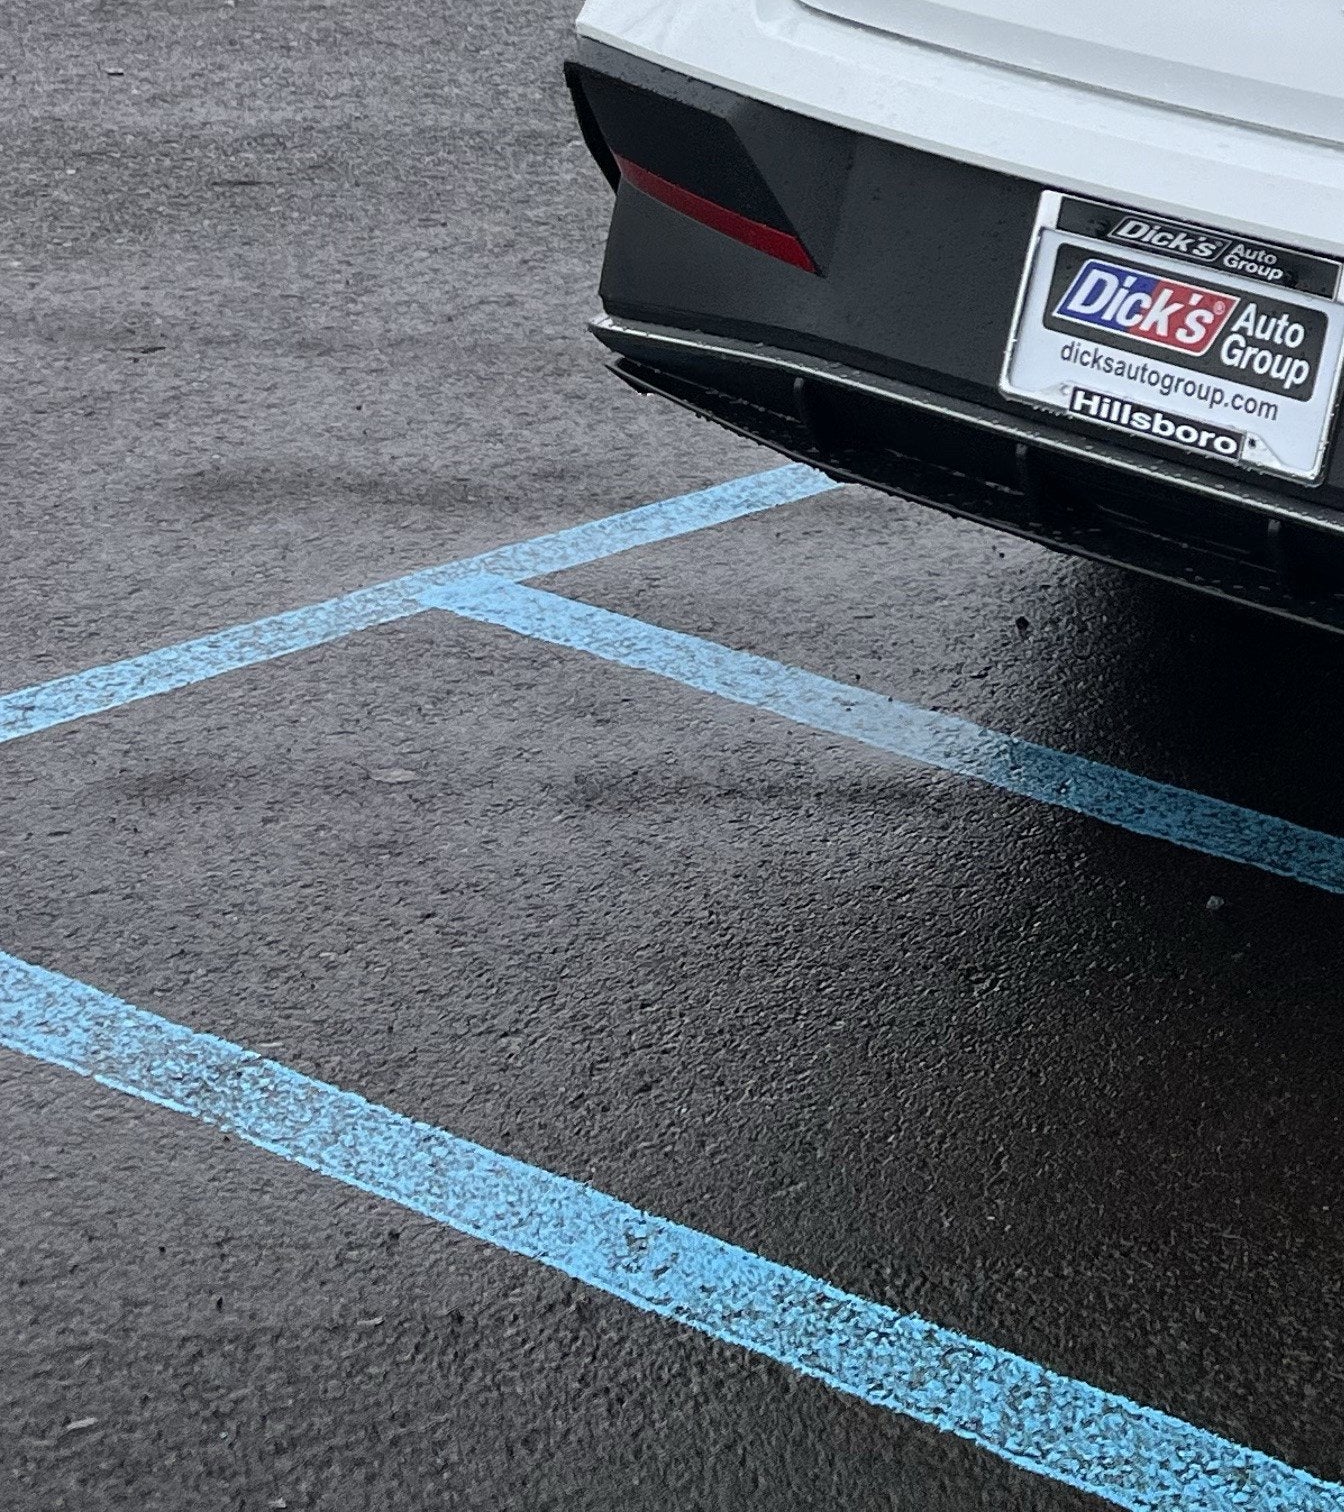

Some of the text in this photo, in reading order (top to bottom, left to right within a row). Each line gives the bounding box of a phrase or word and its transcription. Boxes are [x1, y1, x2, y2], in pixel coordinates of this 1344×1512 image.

[1116, 219, 1278, 265] Dick's Auto
[1223, 255, 1284, 281] Group
[1067, 268, 1306, 348] Dick's Auto
[1060, 341, 1279, 421] dicksautogroup.com
[1220, 333, 1311, 390] Group
[1073, 389, 1239, 455] Hillsboro
